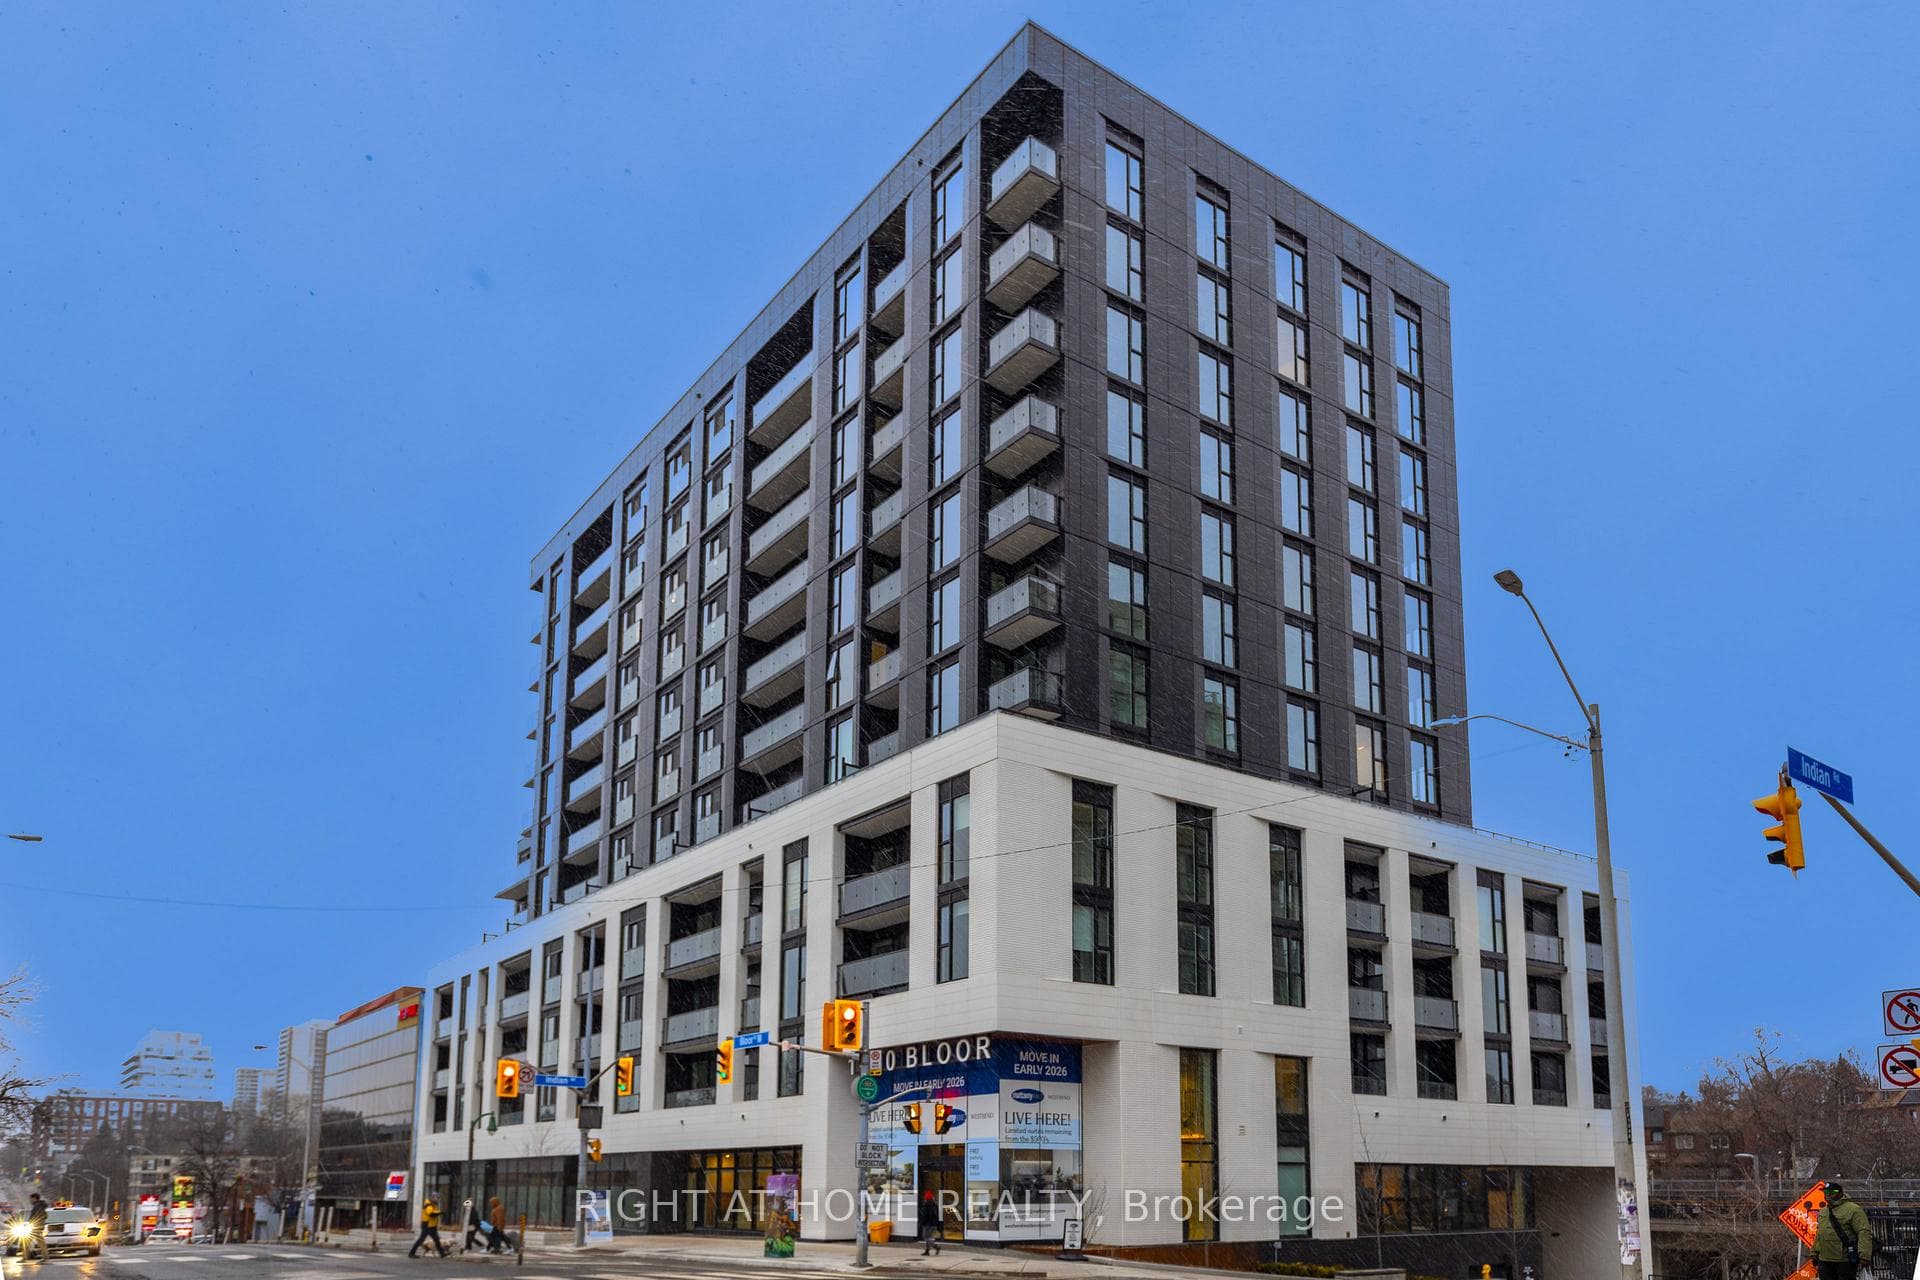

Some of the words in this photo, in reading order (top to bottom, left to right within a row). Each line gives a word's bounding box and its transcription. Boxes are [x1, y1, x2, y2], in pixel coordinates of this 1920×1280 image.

[1802, 756, 1831, 788] Indian
[906, 1036, 992, 1069] BLOOR
[1020, 1051, 1048, 1063] MOVE
[1050, 1054, 1060, 1064] IN
[1014, 1064, 1043, 1075] EARLY
[1045, 1066, 1068, 1077] 2026
[545, 1076, 569, 1084] Indian
[893, 1080, 914, 1093] MOVE
[923, 1078, 945, 1090] EARLY
[946, 1076, 965, 1088] 2026
[1005, 1111, 1032, 1125] LIVE
[1036, 1112, 1071, 1126] HERE!
[1005, 1126, 1027, 1134] Limited
